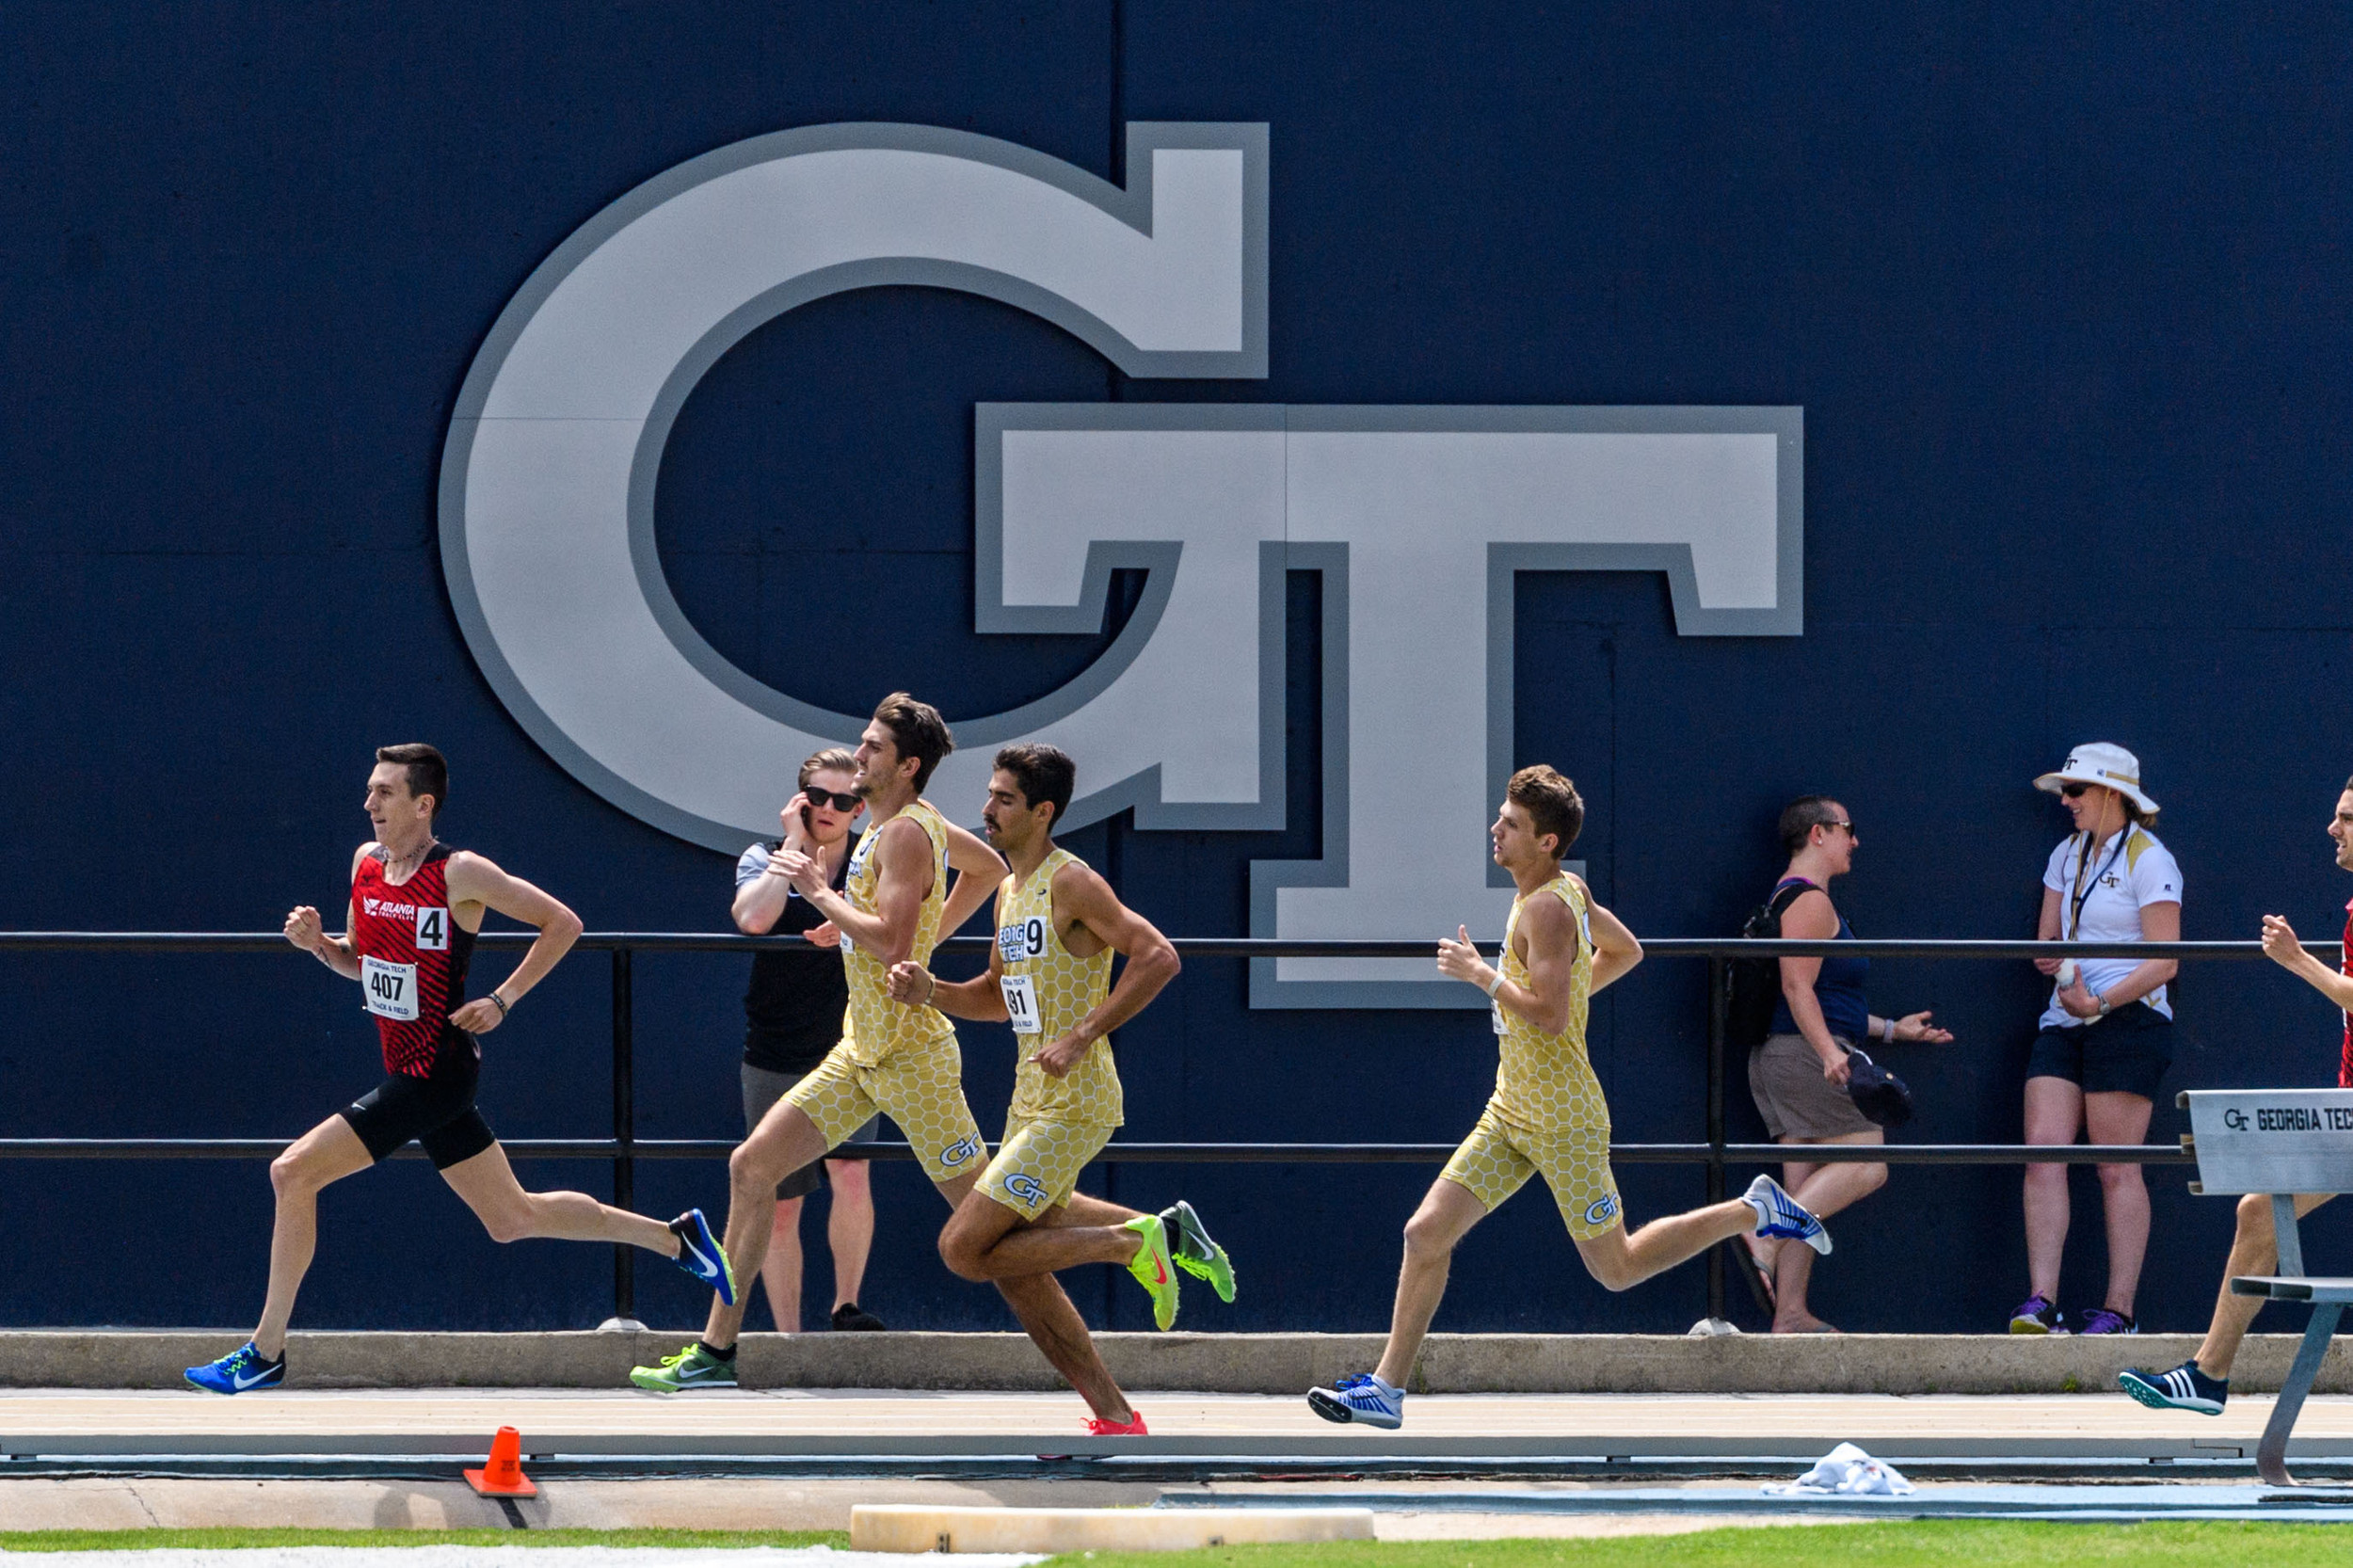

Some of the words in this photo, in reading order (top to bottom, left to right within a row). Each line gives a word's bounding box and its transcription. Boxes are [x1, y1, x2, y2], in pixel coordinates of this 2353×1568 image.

[439, 121, 1804, 1008] GT
[2099, 871, 2121, 888] GT
[379, 901, 415, 916] ATLANTA
[420, 910, 443, 947] 4
[1026, 919, 1043, 955] 9
[367, 958, 390, 971] GEORGIA
[391, 965, 407, 974] TECH
[371, 971, 404, 1001] 407
[1013, 978, 1026, 986] TECH
[393, 1006, 409, 1015] FIELD
[2224, 1108, 2249, 1131] GT
[2257, 1108, 2322, 1131] GEORGIA
[2324, 1108, 2353, 1130] TEC
[939, 1130, 981, 1167] GT
[1003, 1173, 1048, 1208] GT
[1584, 1192, 1619, 1225] GT
